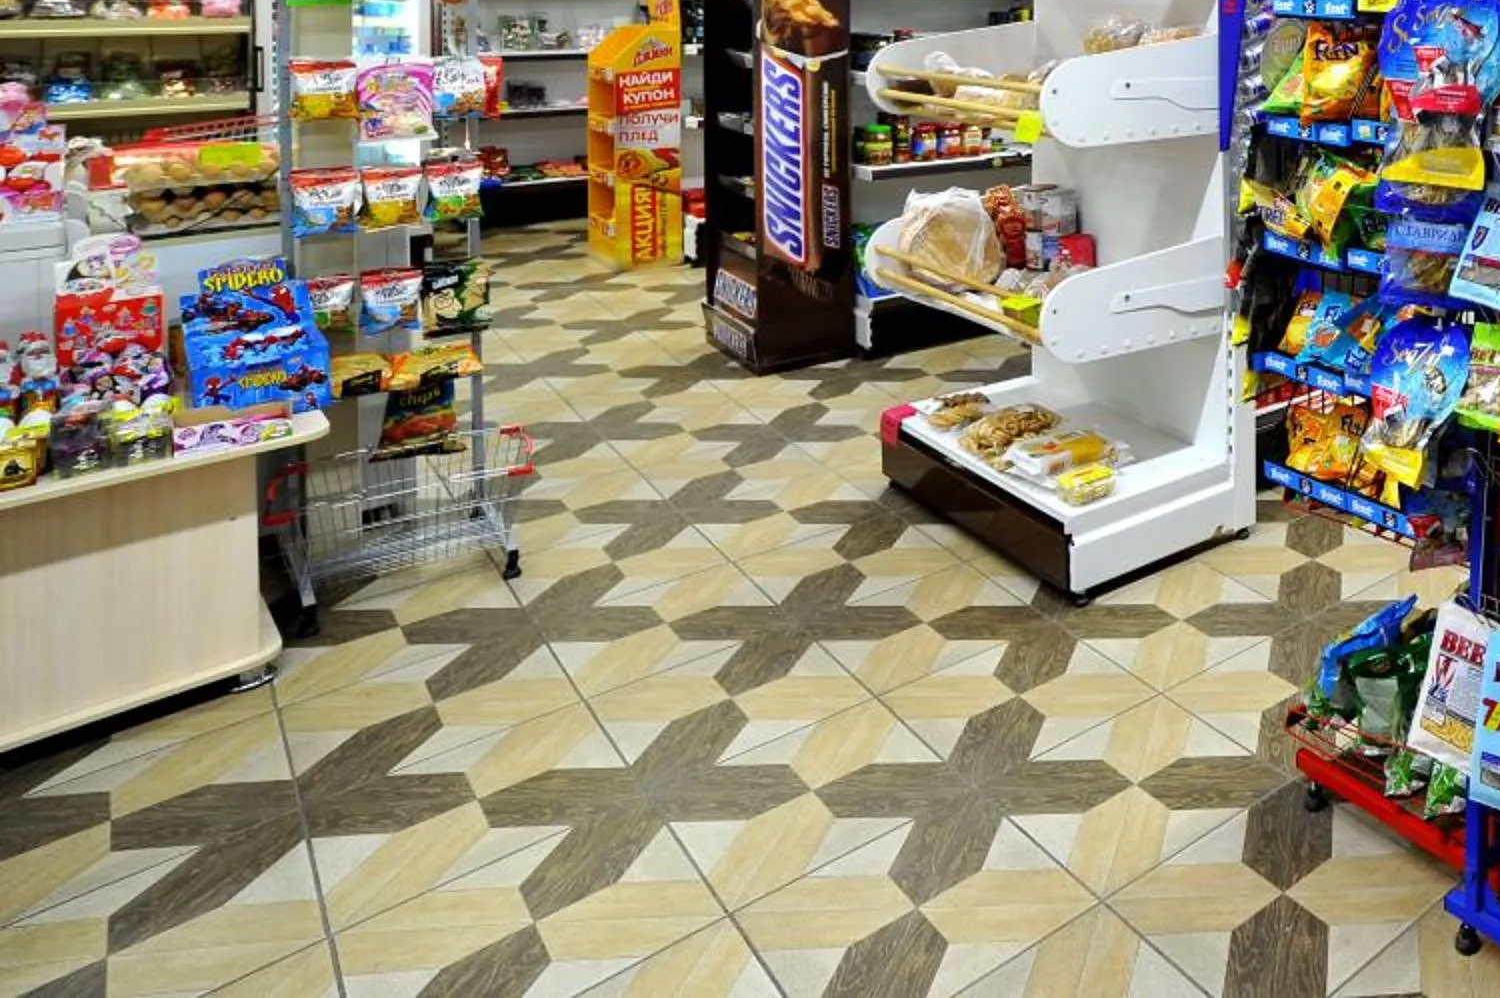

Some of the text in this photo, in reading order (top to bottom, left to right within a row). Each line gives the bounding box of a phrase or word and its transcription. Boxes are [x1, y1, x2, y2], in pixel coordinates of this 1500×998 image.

[619, 70, 673, 88] НАЙДИ
[623, 88, 675, 105] КУПОН
[619, 109, 679, 127] ПОЛУЧИ
[619, 129, 660, 144] ПЛЕД
[763, 56, 803, 260] SNICKERS
[634, 185, 656, 260] АКЦИЯ!
